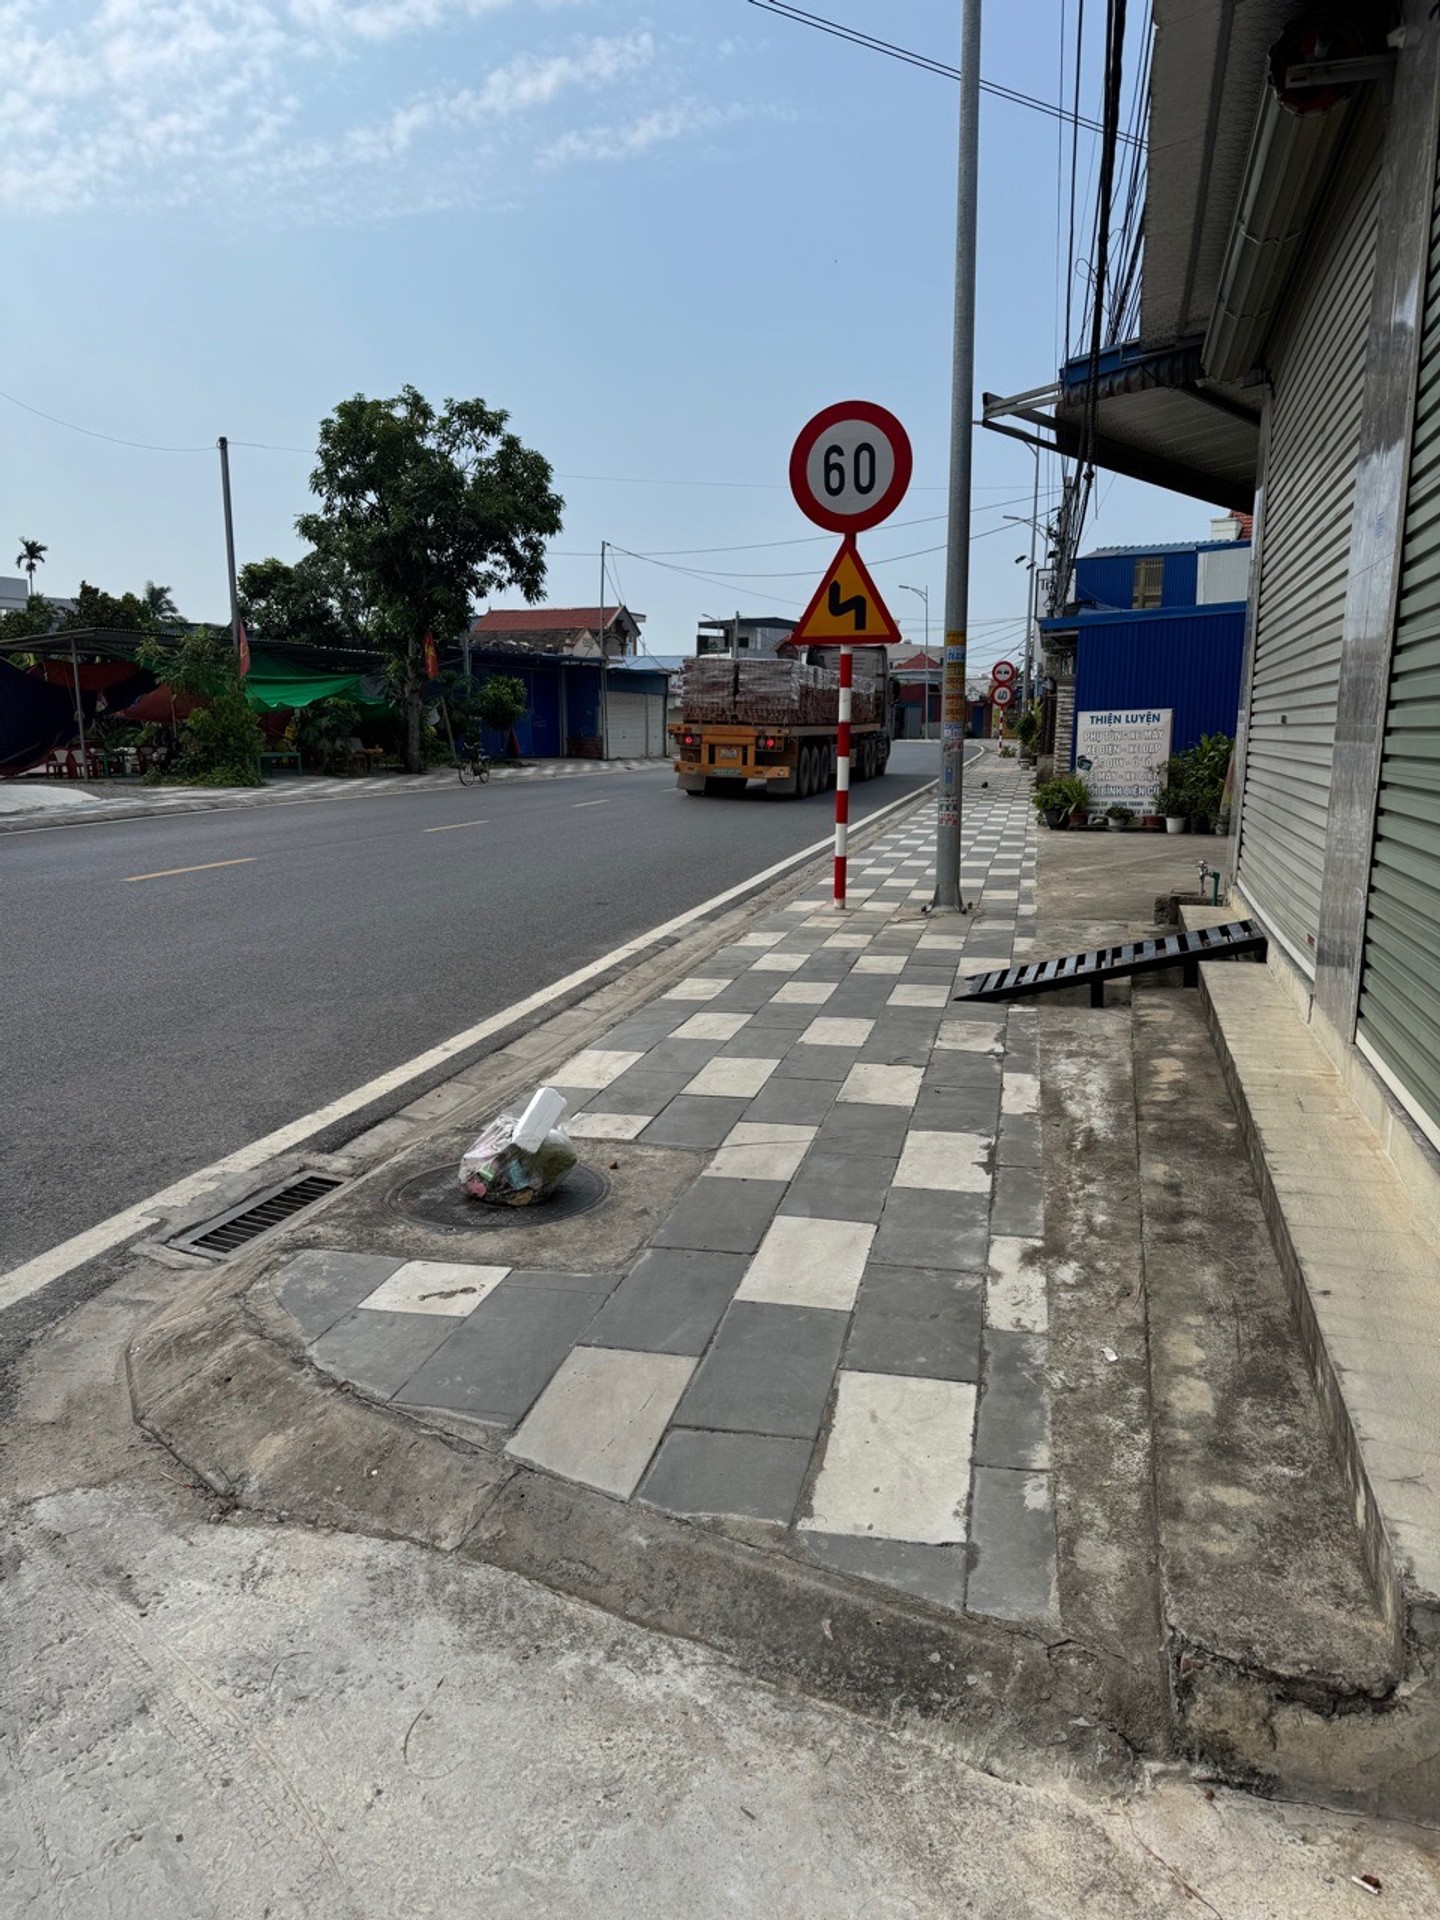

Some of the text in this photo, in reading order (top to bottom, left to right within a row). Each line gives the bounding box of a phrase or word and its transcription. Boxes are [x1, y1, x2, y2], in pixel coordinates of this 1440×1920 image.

[824, 442, 876, 497] 60
[1089, 711, 1160, 727] THIỆN LUYỆN
[1143, 728, 1164, 741] MÁY
